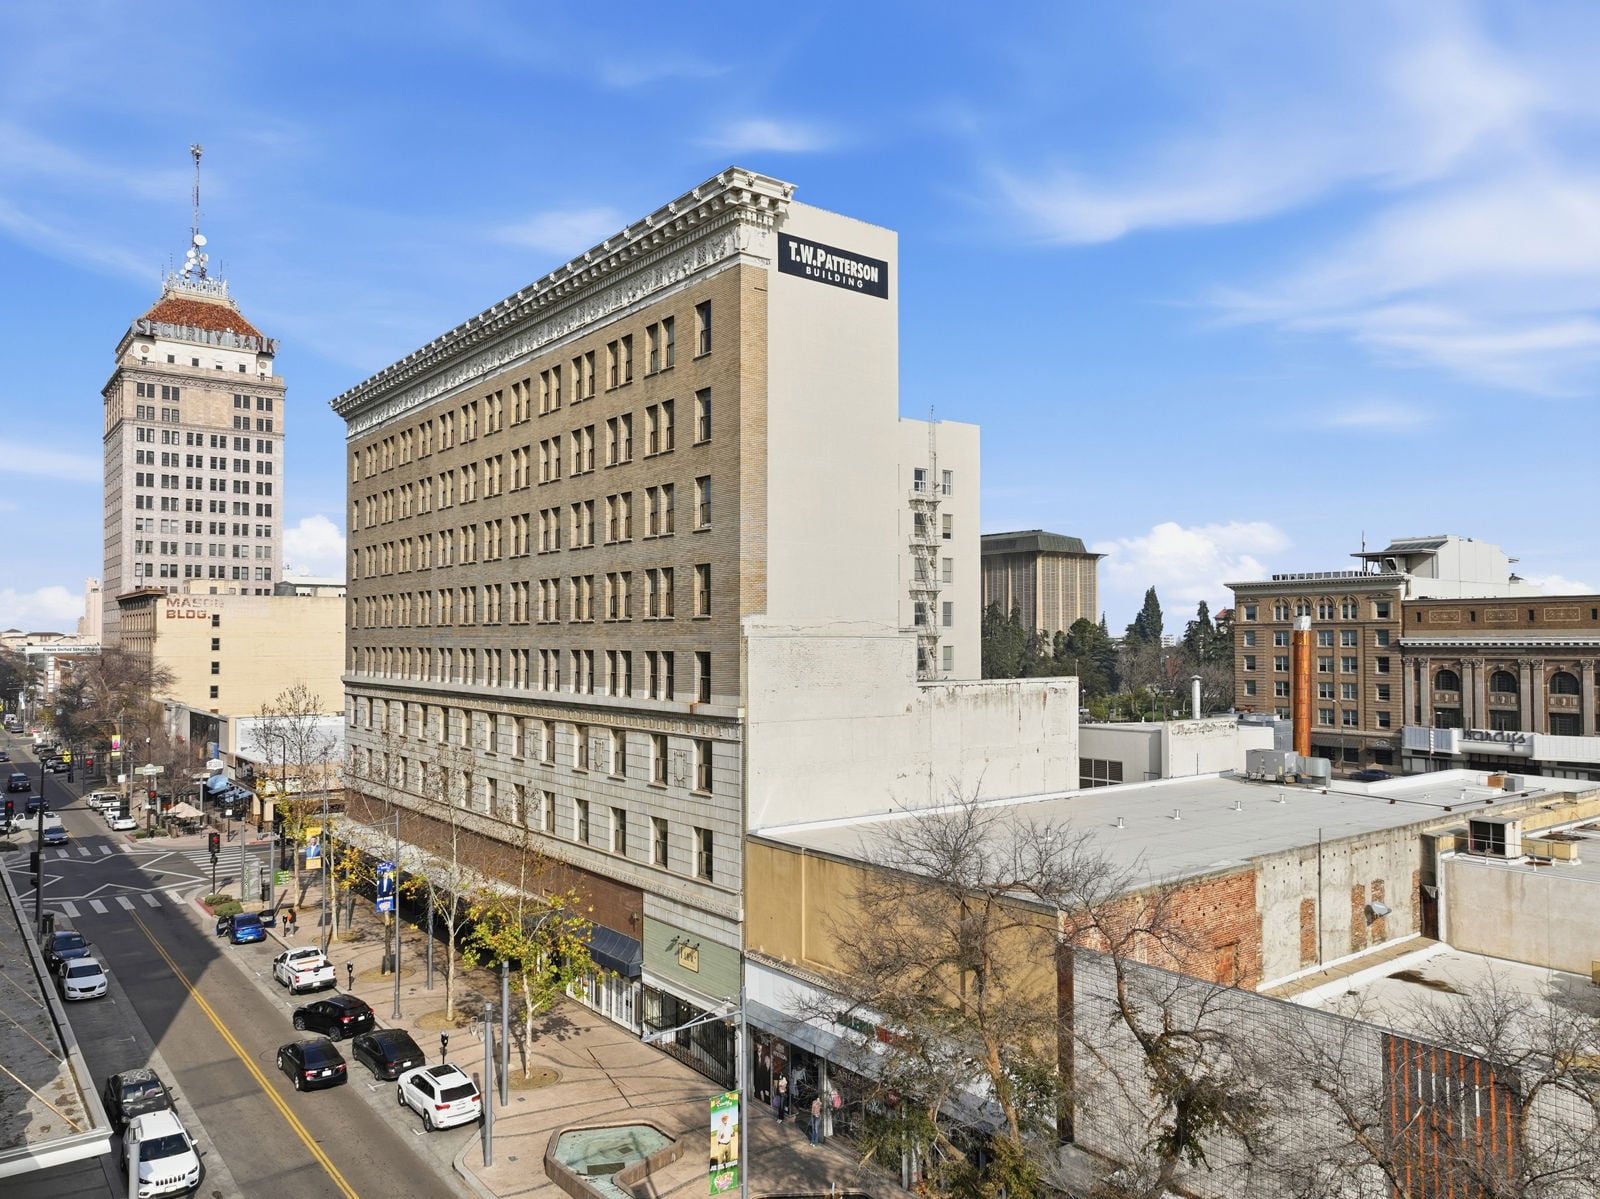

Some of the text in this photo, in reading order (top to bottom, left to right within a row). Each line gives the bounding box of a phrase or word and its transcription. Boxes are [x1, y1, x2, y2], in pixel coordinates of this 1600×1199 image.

[806, 266, 864, 288] BUILDING
[166, 598, 225, 608] MASON
[166, 609, 211, 619] BLDG.
